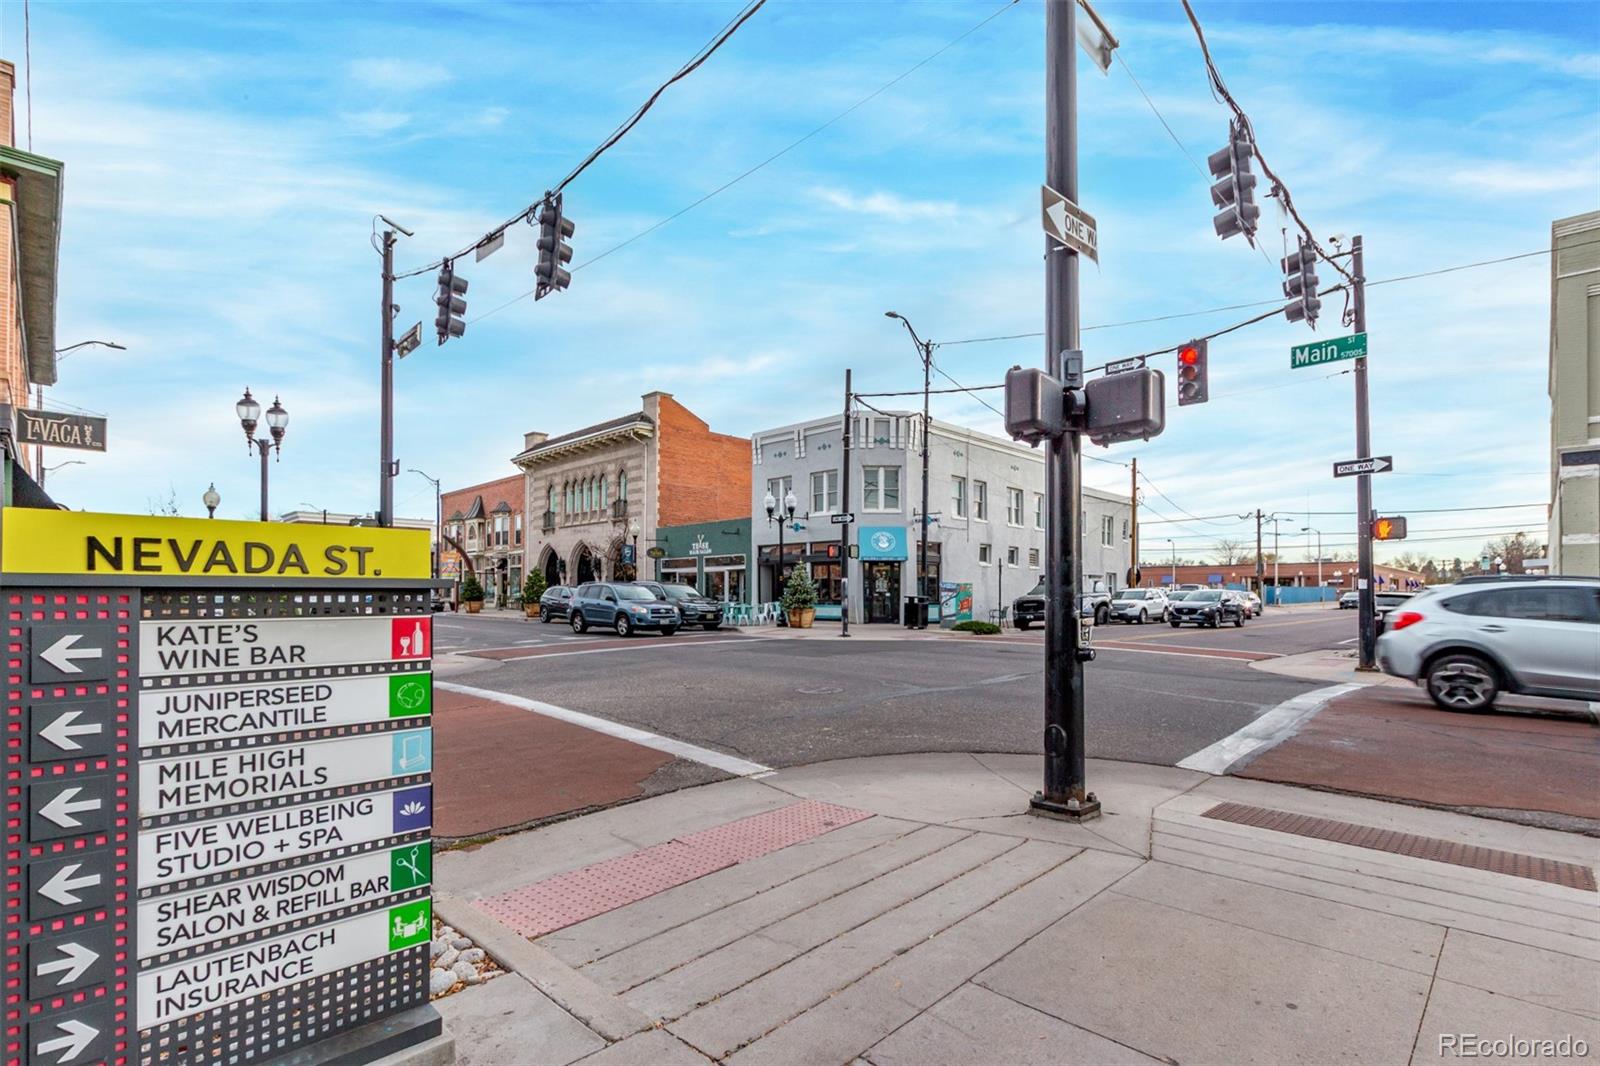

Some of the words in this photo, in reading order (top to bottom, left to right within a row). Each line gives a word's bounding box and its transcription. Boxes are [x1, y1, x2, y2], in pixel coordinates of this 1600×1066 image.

[1065, 214, 1084, 240] ONE
[1296, 344, 1337, 366] Main
[1340, 465, 1353, 473] ONE
[1358, 462, 1373, 470] WAY
[86, 536, 309, 576] NEVADA
[323, 545, 382, 577] ST.
[157, 624, 258, 647] KATE'S
[158, 648, 240, 670] WINE
[251, 645, 306, 667] BAR
[156, 685, 332, 716] JUNIPERSEED
[159, 706, 327, 739] MERCANTILE
[159, 758, 228, 785] MILE
[240, 747, 304, 774] HIGH
[159, 766, 328, 809] MEMORIALS
[156, 826, 218, 854] FIVE
[226, 798, 374, 840] WELLBEING
[156, 840, 265, 879] STUDIO
[275, 838, 290, 853] +
[298, 827, 343, 852] SPA
[156, 887, 242, 923] SHEAR
[248, 864, 345, 901] WISDOM
[156, 909, 245, 947] SALON
[253, 905, 270, 923] &
[276, 888, 345, 919] REFILL
[350, 875, 389, 900] BAR
[156, 928, 335, 994] LAUTENBACH
[156, 956, 314, 1018] INSURANCE
